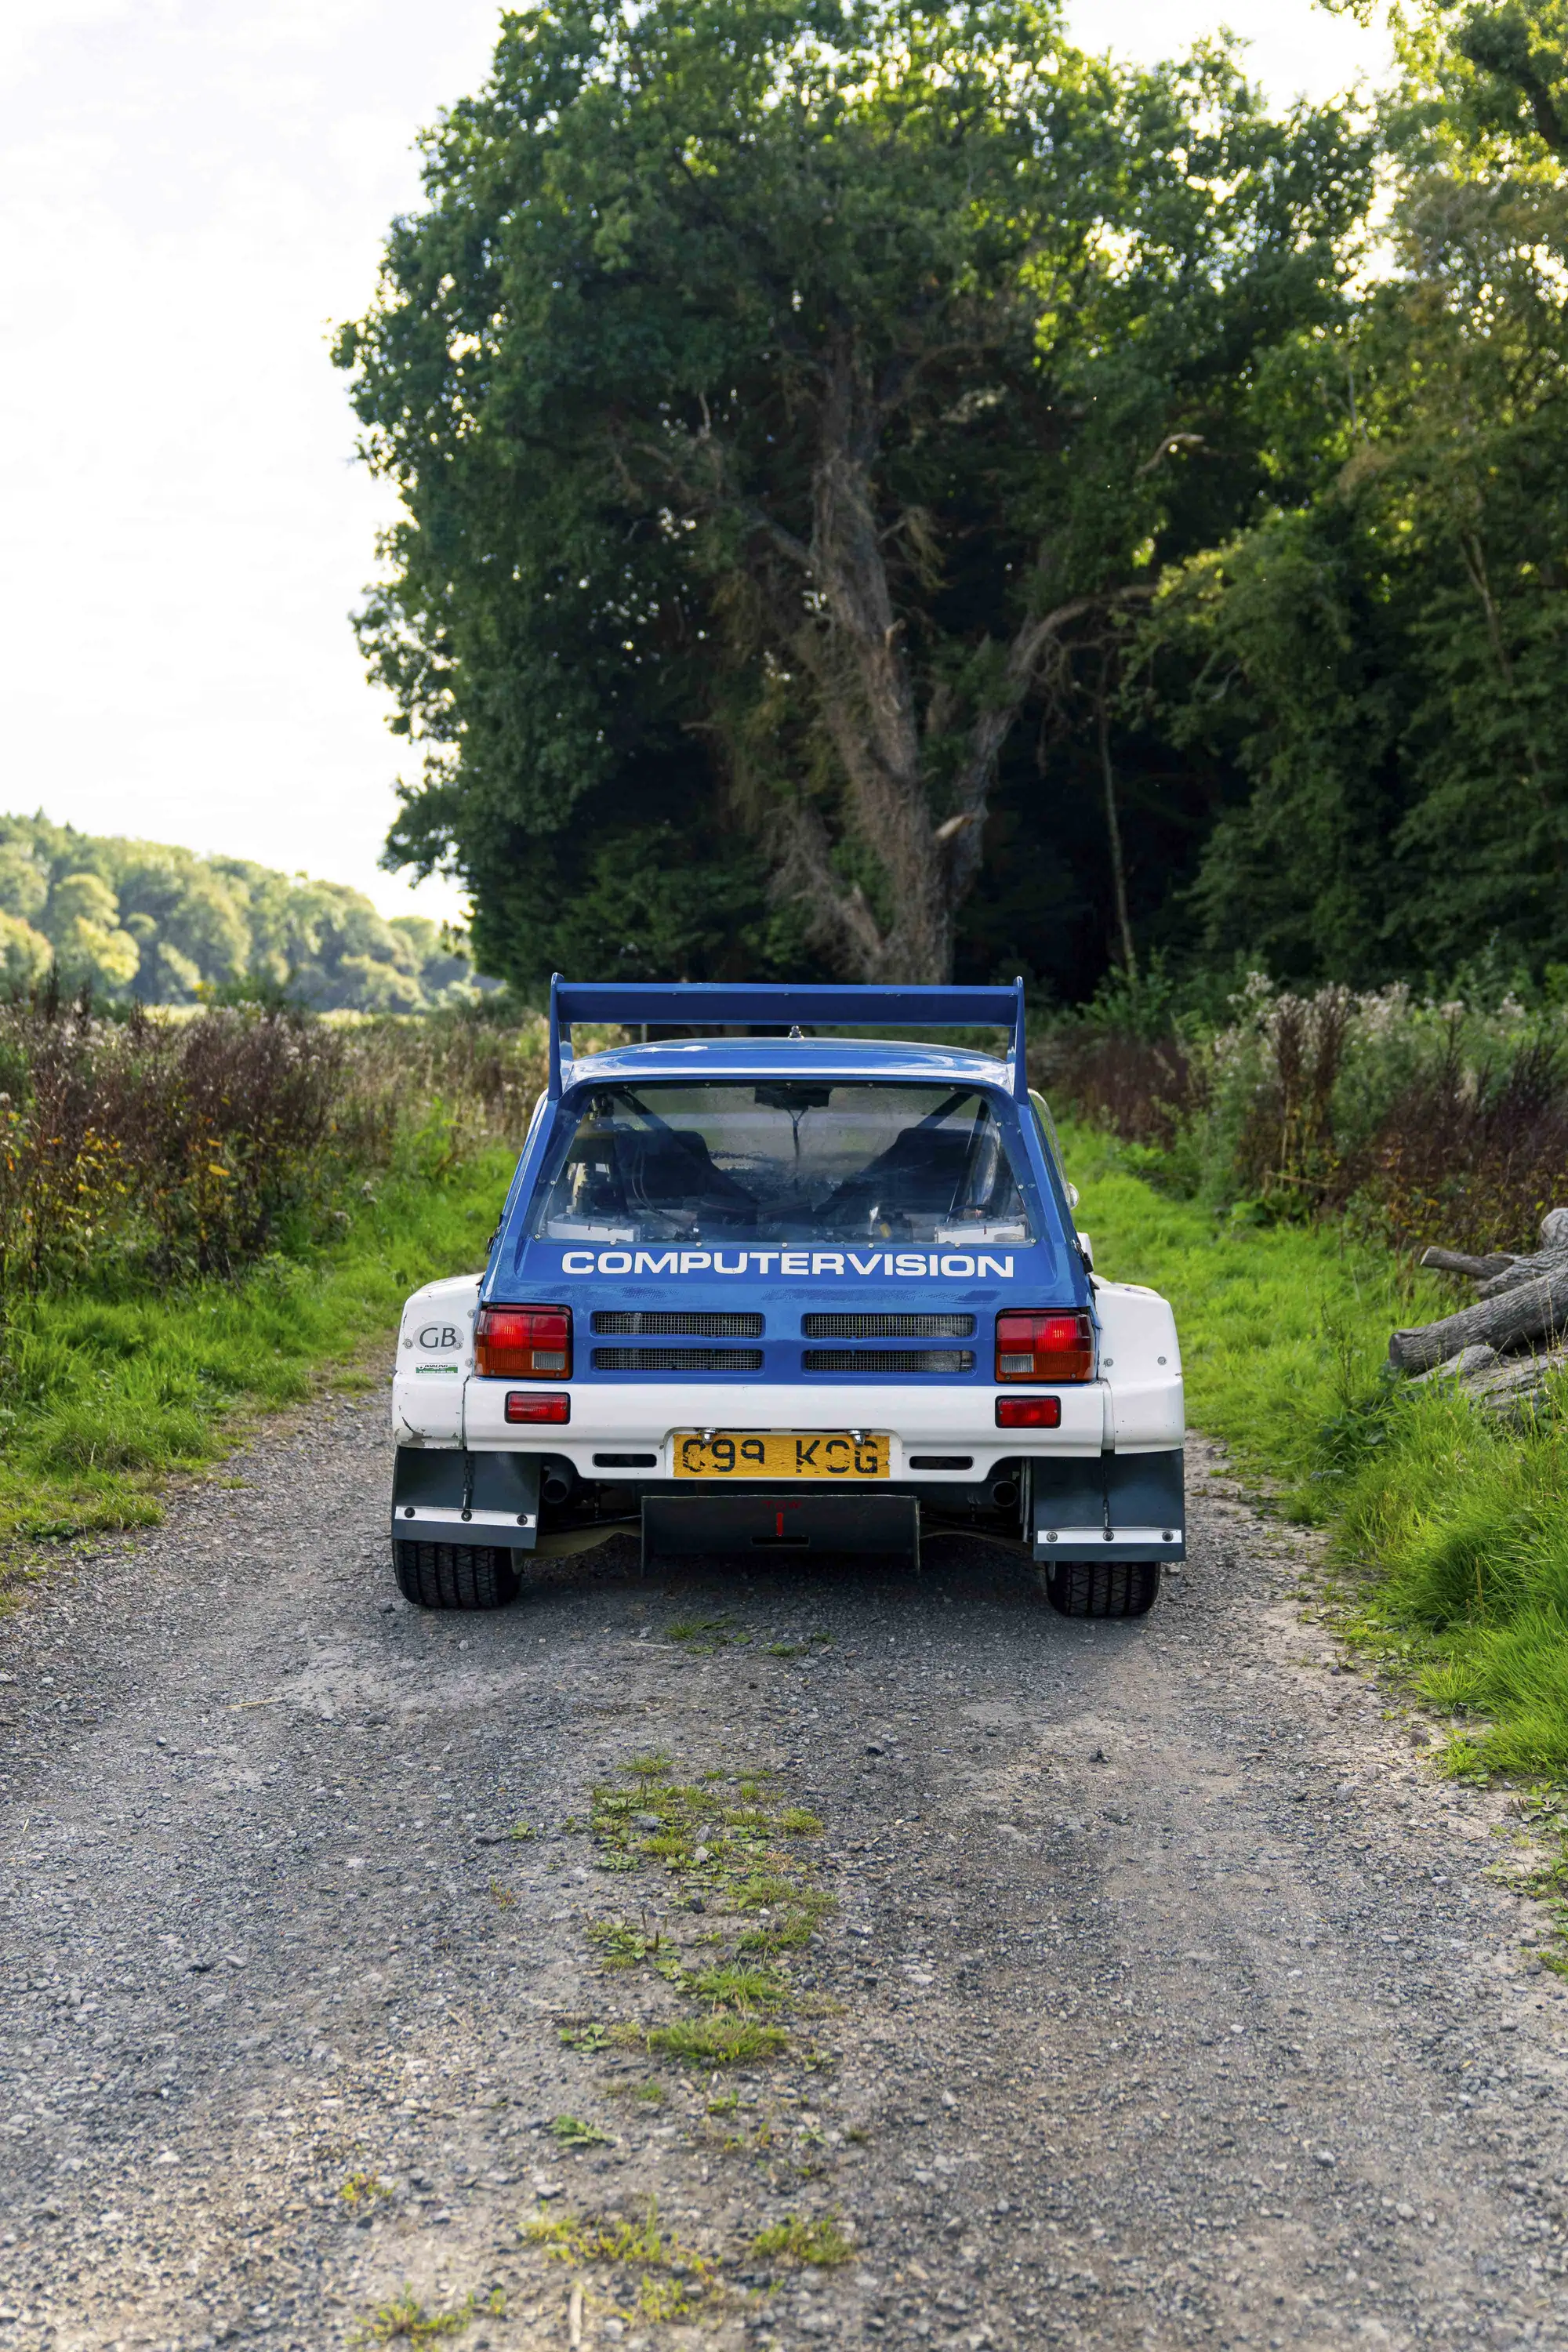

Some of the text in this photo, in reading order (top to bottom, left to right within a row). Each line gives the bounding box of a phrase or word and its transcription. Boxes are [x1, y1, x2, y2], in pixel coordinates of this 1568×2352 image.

[561, 1251, 1014, 1278] COMPUTERVISION
[419, 1327, 457, 1348] GB
[761, 1500, 802, 1510] TOW
